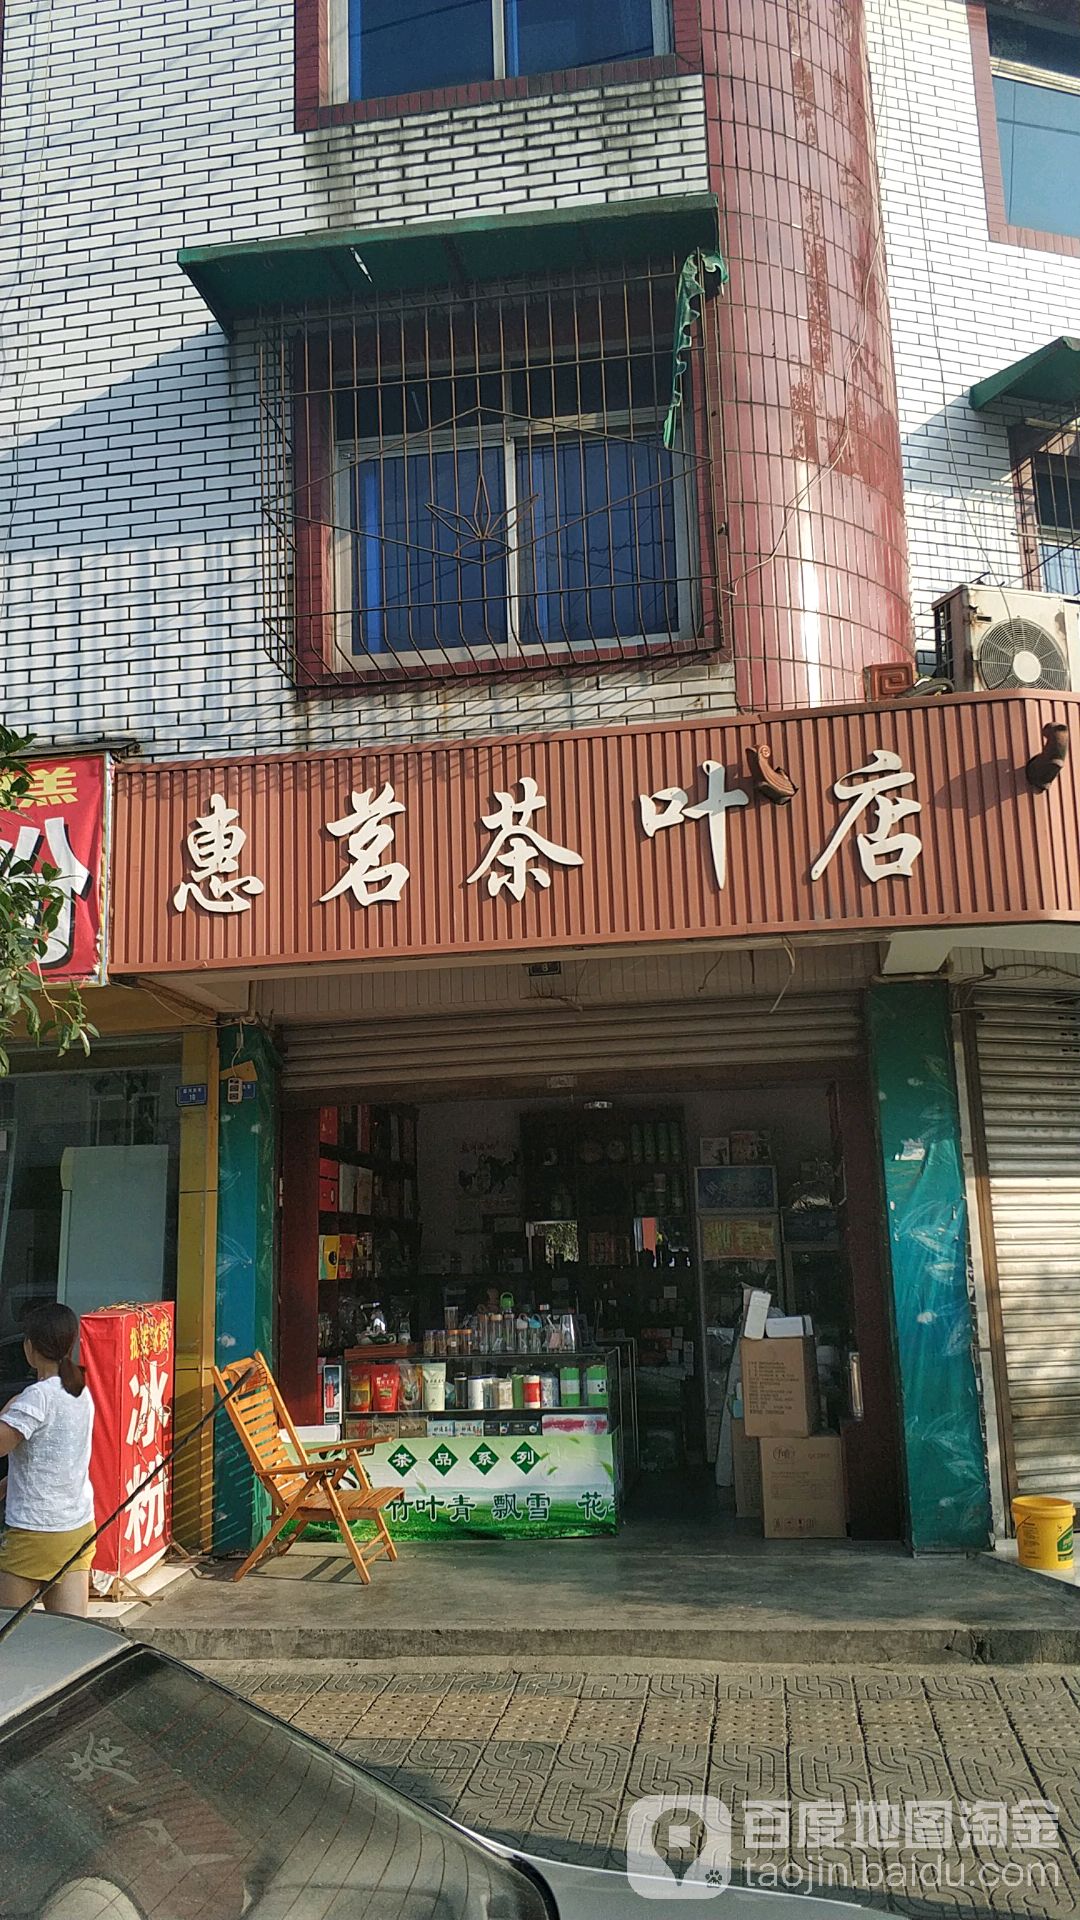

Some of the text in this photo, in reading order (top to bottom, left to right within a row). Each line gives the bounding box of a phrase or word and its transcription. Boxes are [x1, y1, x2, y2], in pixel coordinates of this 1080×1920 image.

[174, 750, 922, 913] 惠茗茶叶店
[124, 1361, 168, 1555] 冰粉
[384, 1491, 616, 1522] 竹叶青 飘雪 花
[392, 1450, 535, 1468] 茶品系列
